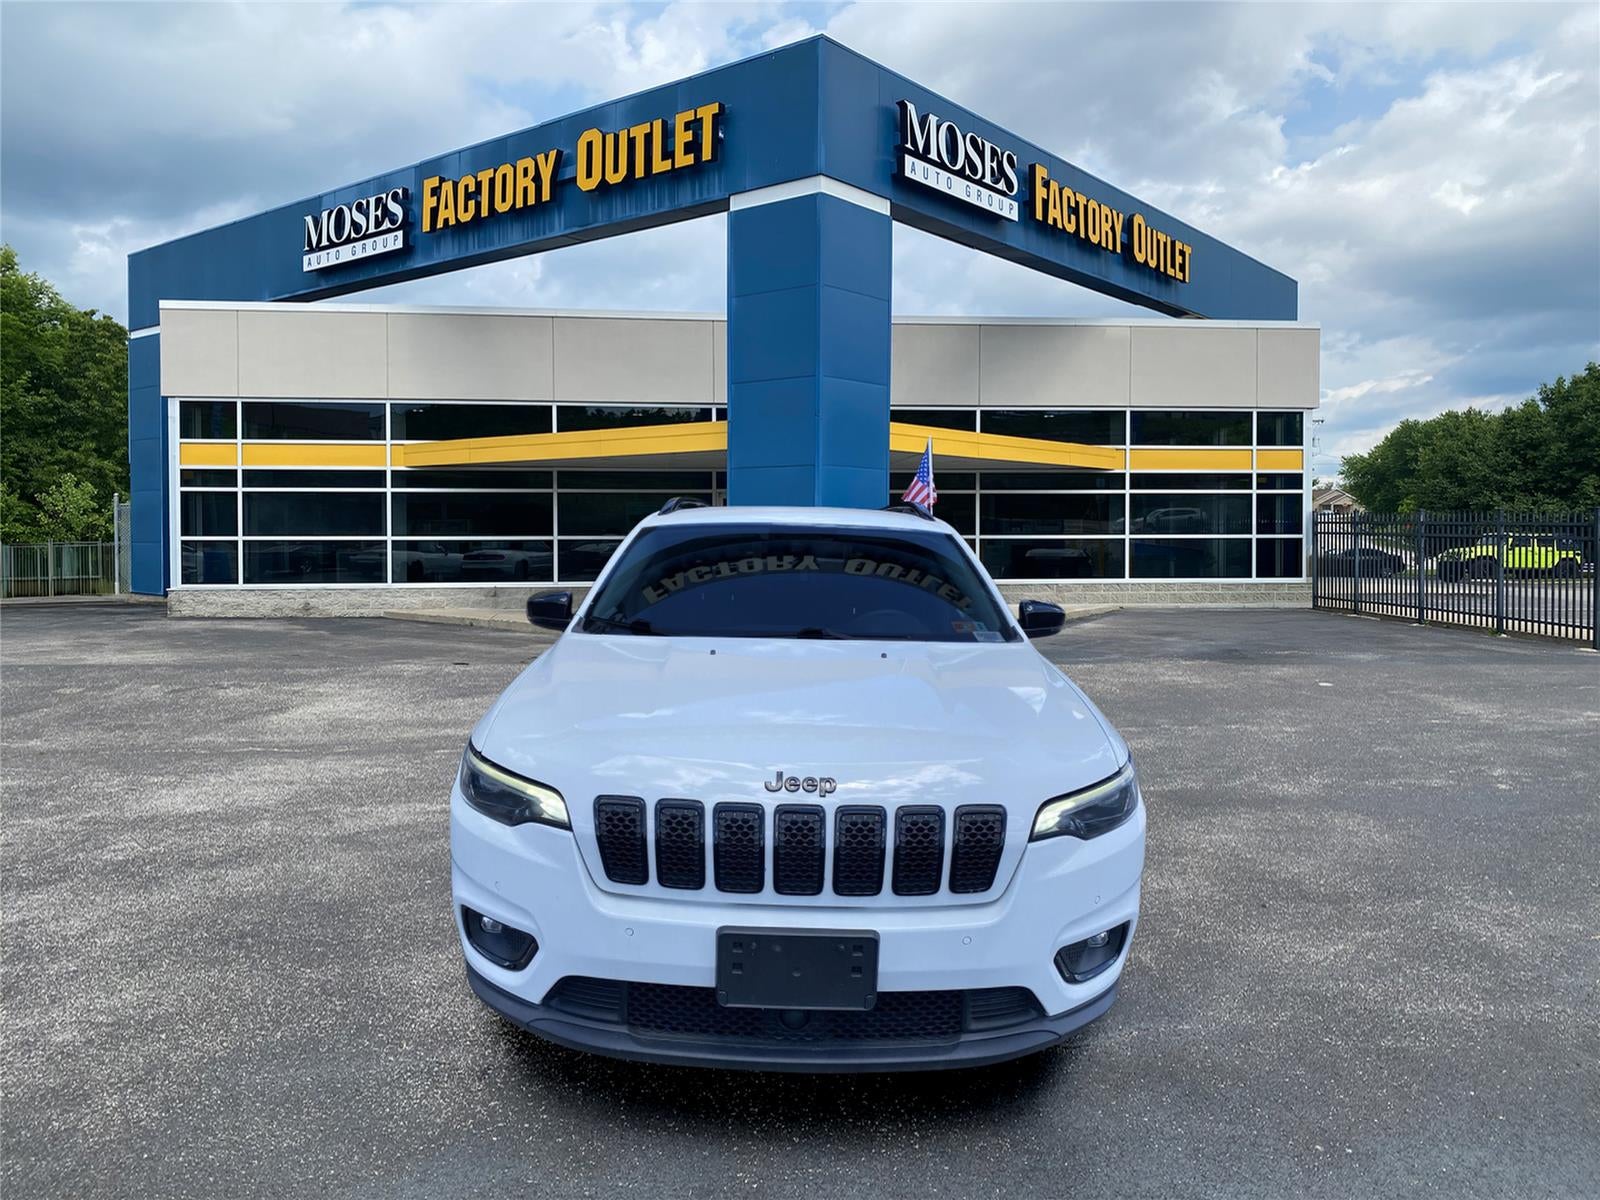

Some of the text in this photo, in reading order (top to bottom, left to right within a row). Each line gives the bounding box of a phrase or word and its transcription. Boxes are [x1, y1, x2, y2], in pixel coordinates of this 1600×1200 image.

[422, 102, 720, 233] FACTORY OUTLET
[904, 100, 1018, 196] MOSES
[303, 187, 404, 251] MOSES
[909, 161, 1015, 215] AUTO GROUP
[307, 234, 399, 267] AUTO GROUP
[1035, 163, 1192, 283] FACTORY OUTLET
[764, 771, 837, 797] Jeep
